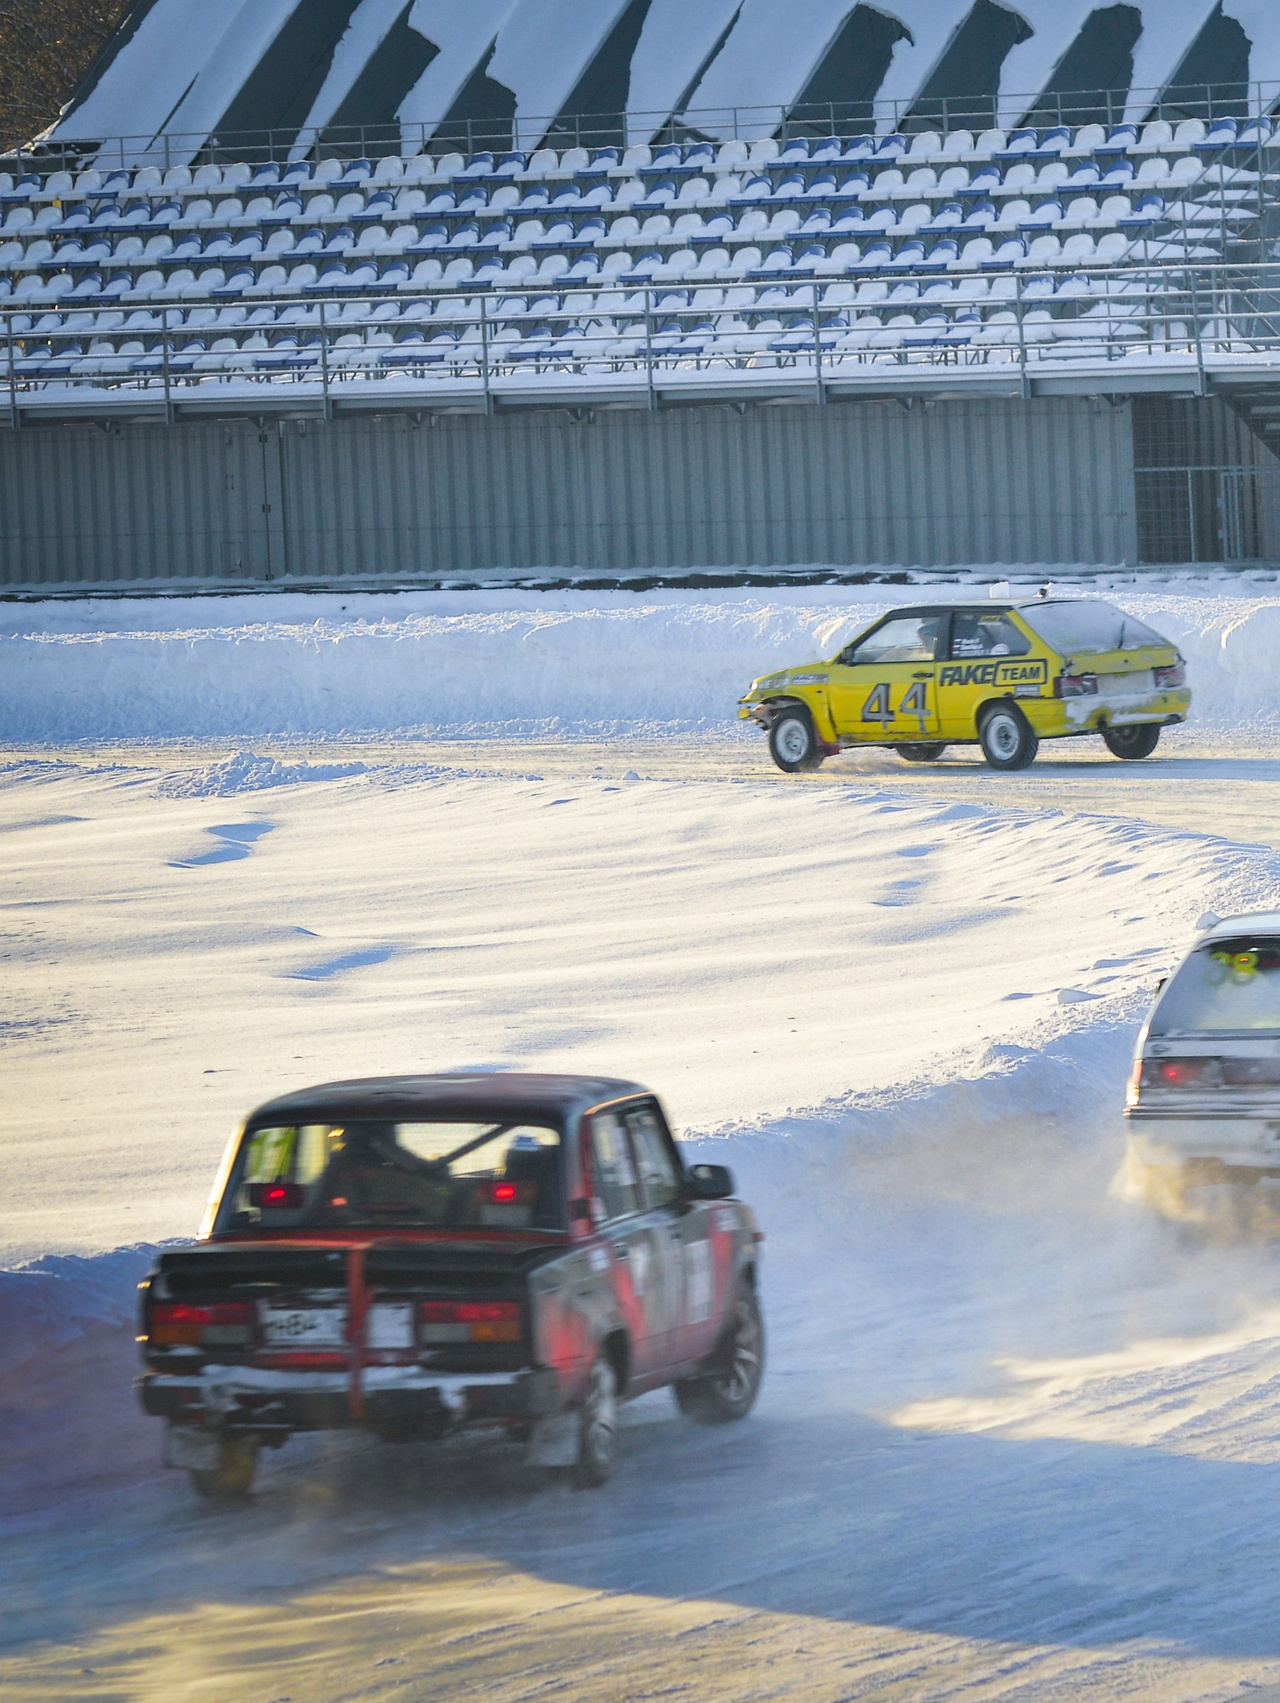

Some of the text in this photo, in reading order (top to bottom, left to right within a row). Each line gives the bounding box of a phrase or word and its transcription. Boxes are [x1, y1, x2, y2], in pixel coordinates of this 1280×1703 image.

[940, 664, 1041, 687] FAKE TEAM
[861, 682, 932, 733] 44
